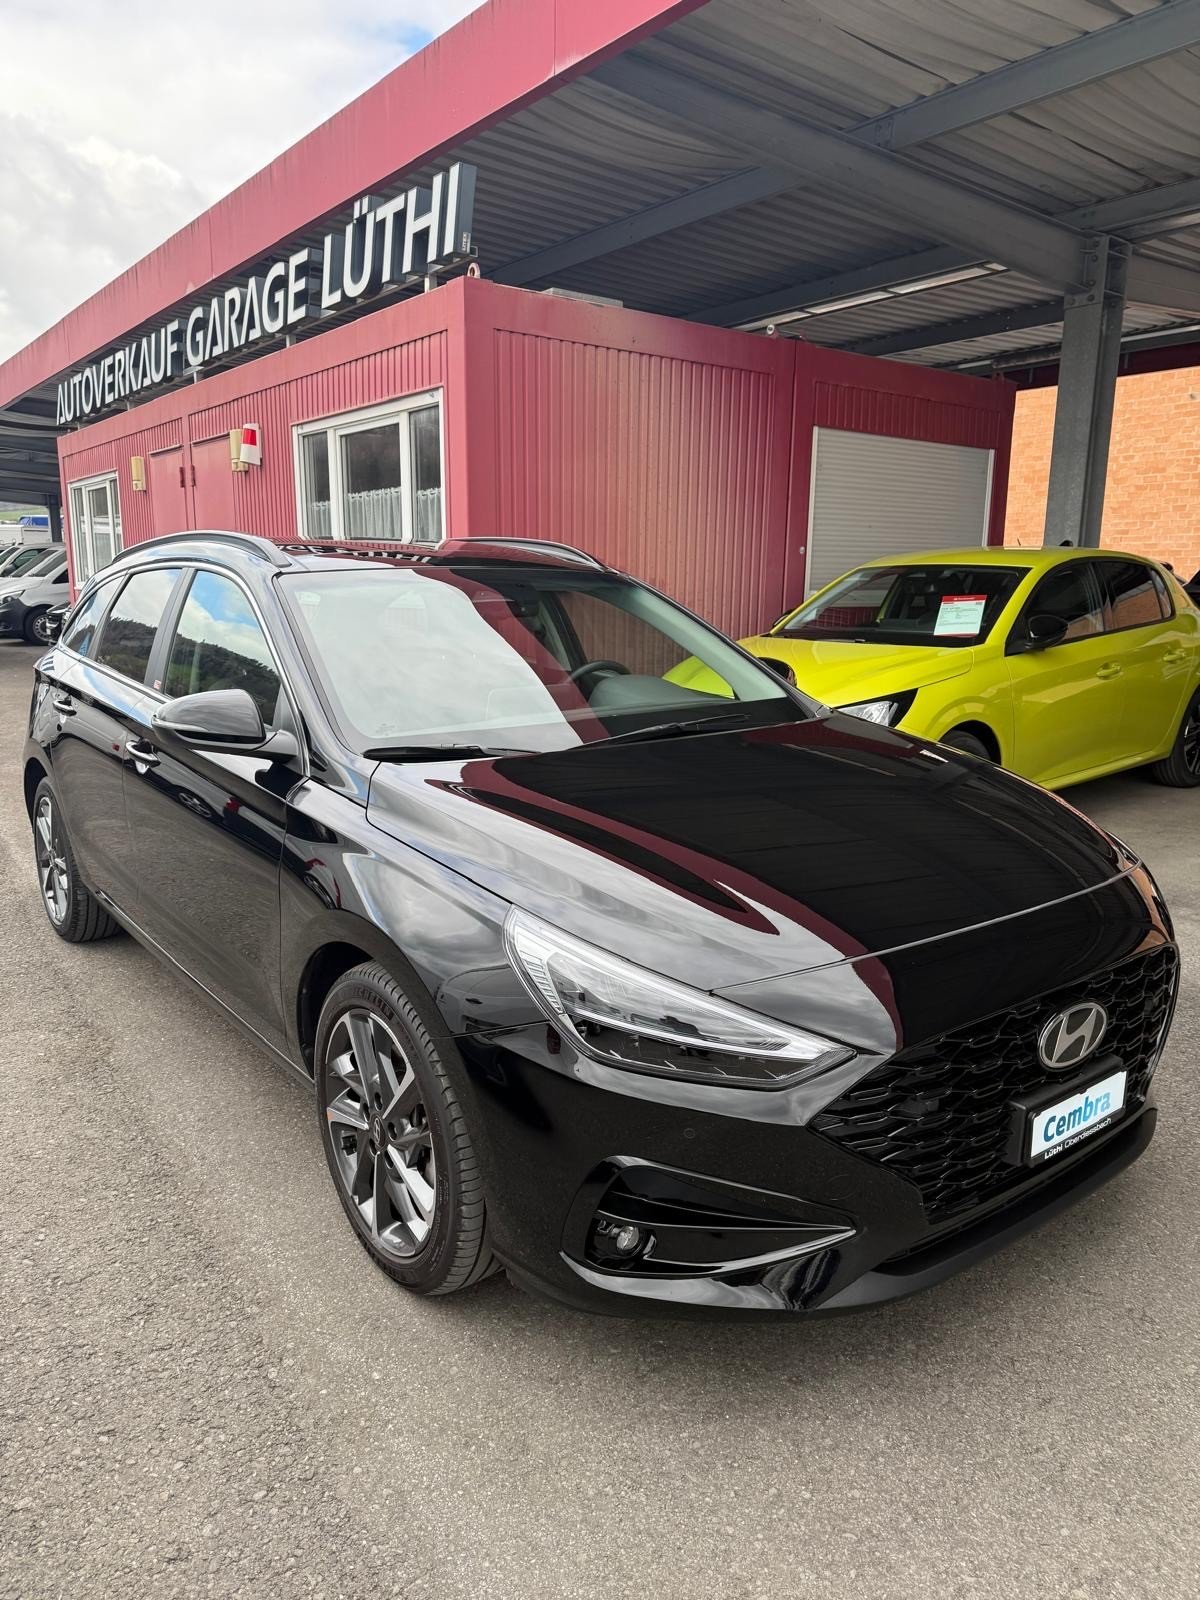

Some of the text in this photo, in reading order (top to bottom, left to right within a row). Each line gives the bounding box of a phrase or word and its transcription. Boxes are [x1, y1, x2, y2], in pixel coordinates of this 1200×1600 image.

[56, 161, 465, 425] AUTOVERKAUF GARAGE LÜTHI
[1043, 1092, 1111, 1142] Cembra
